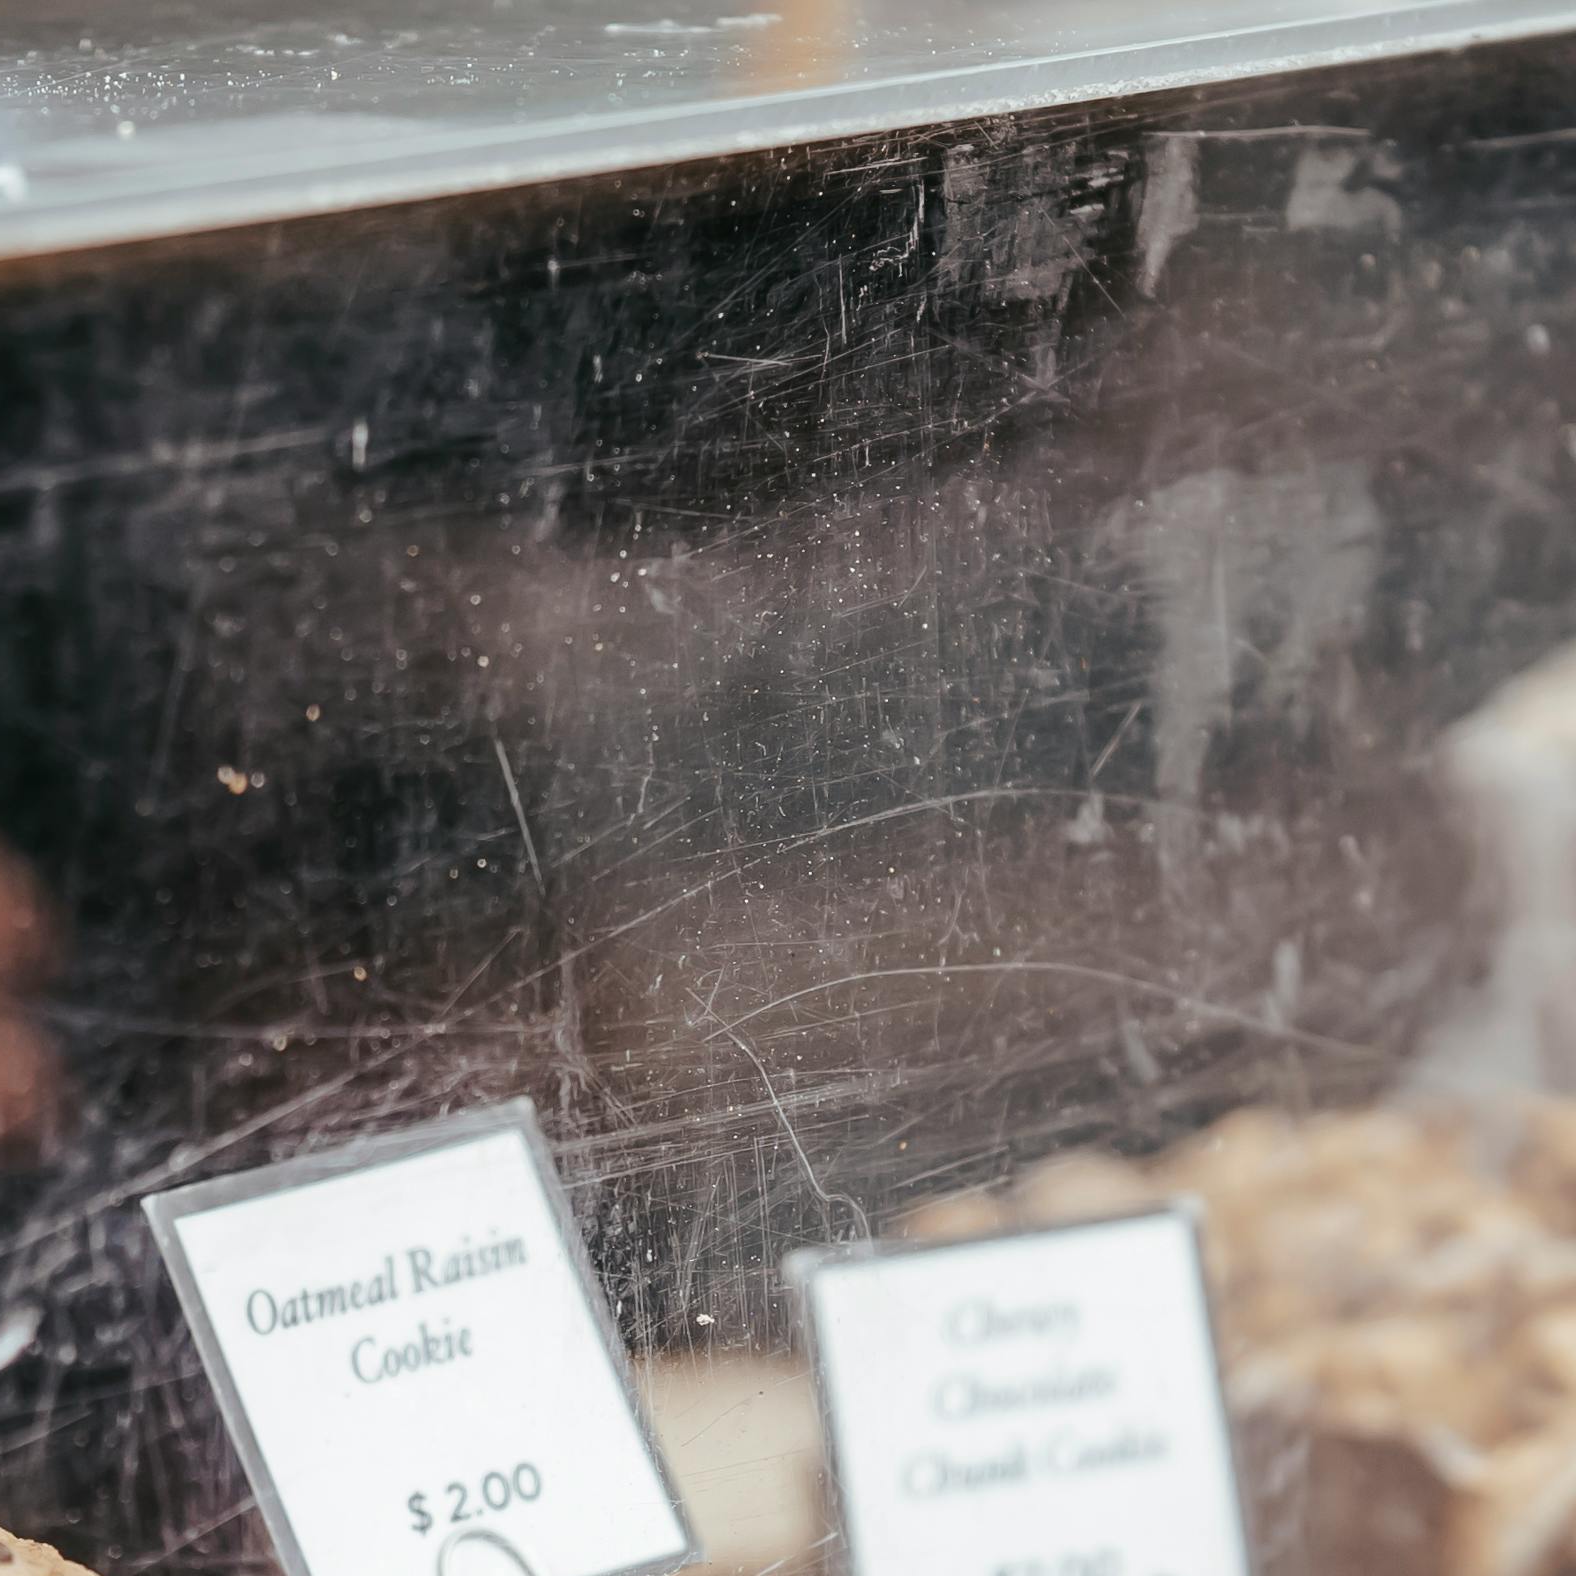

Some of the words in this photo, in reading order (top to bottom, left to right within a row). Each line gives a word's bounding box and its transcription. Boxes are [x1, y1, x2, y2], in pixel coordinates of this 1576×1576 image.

[246, 1255, 399, 1335] Oatmeal
[406, 1229, 526, 1294] Raisin
[350, 1317, 473, 1385] Cookie
